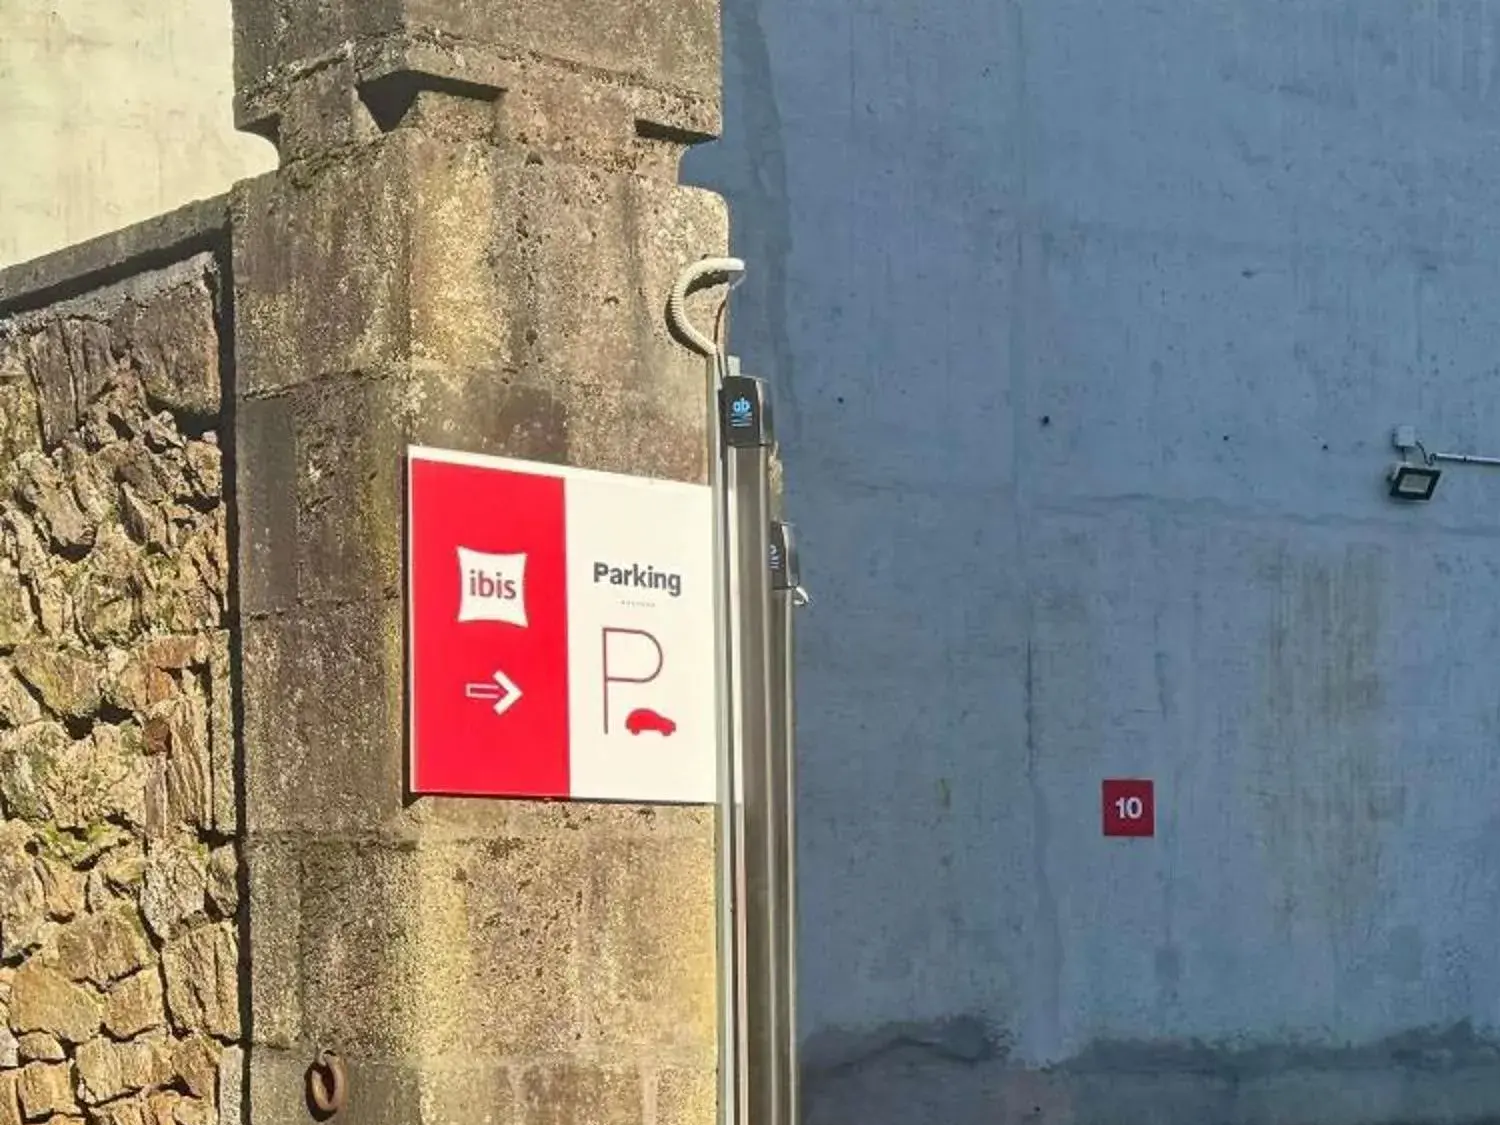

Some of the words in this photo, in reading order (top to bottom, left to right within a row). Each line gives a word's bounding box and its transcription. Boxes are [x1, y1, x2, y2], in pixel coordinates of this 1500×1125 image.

[470, 568, 517, 600] ibis
[593, 561, 681, 597] Parking
[602, 626, 663, 735] P
[1115, 796, 1143, 819] 10
